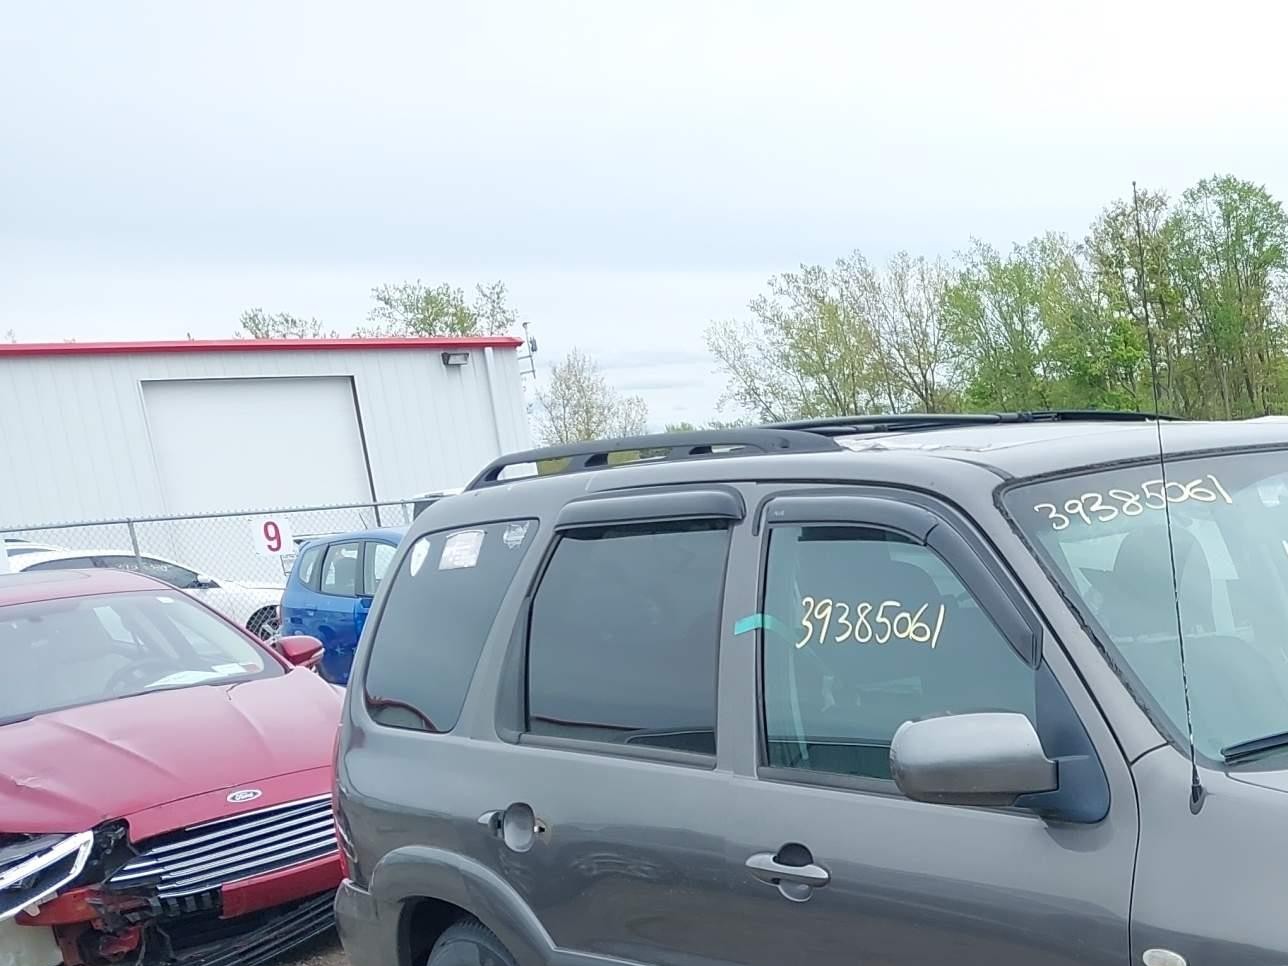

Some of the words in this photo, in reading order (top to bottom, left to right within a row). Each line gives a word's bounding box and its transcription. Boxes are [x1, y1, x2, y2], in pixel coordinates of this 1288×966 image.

[1033, 474, 1233, 530] 39385061
[263, 520, 282, 552] 9
[795, 596, 945, 650] 39385061
